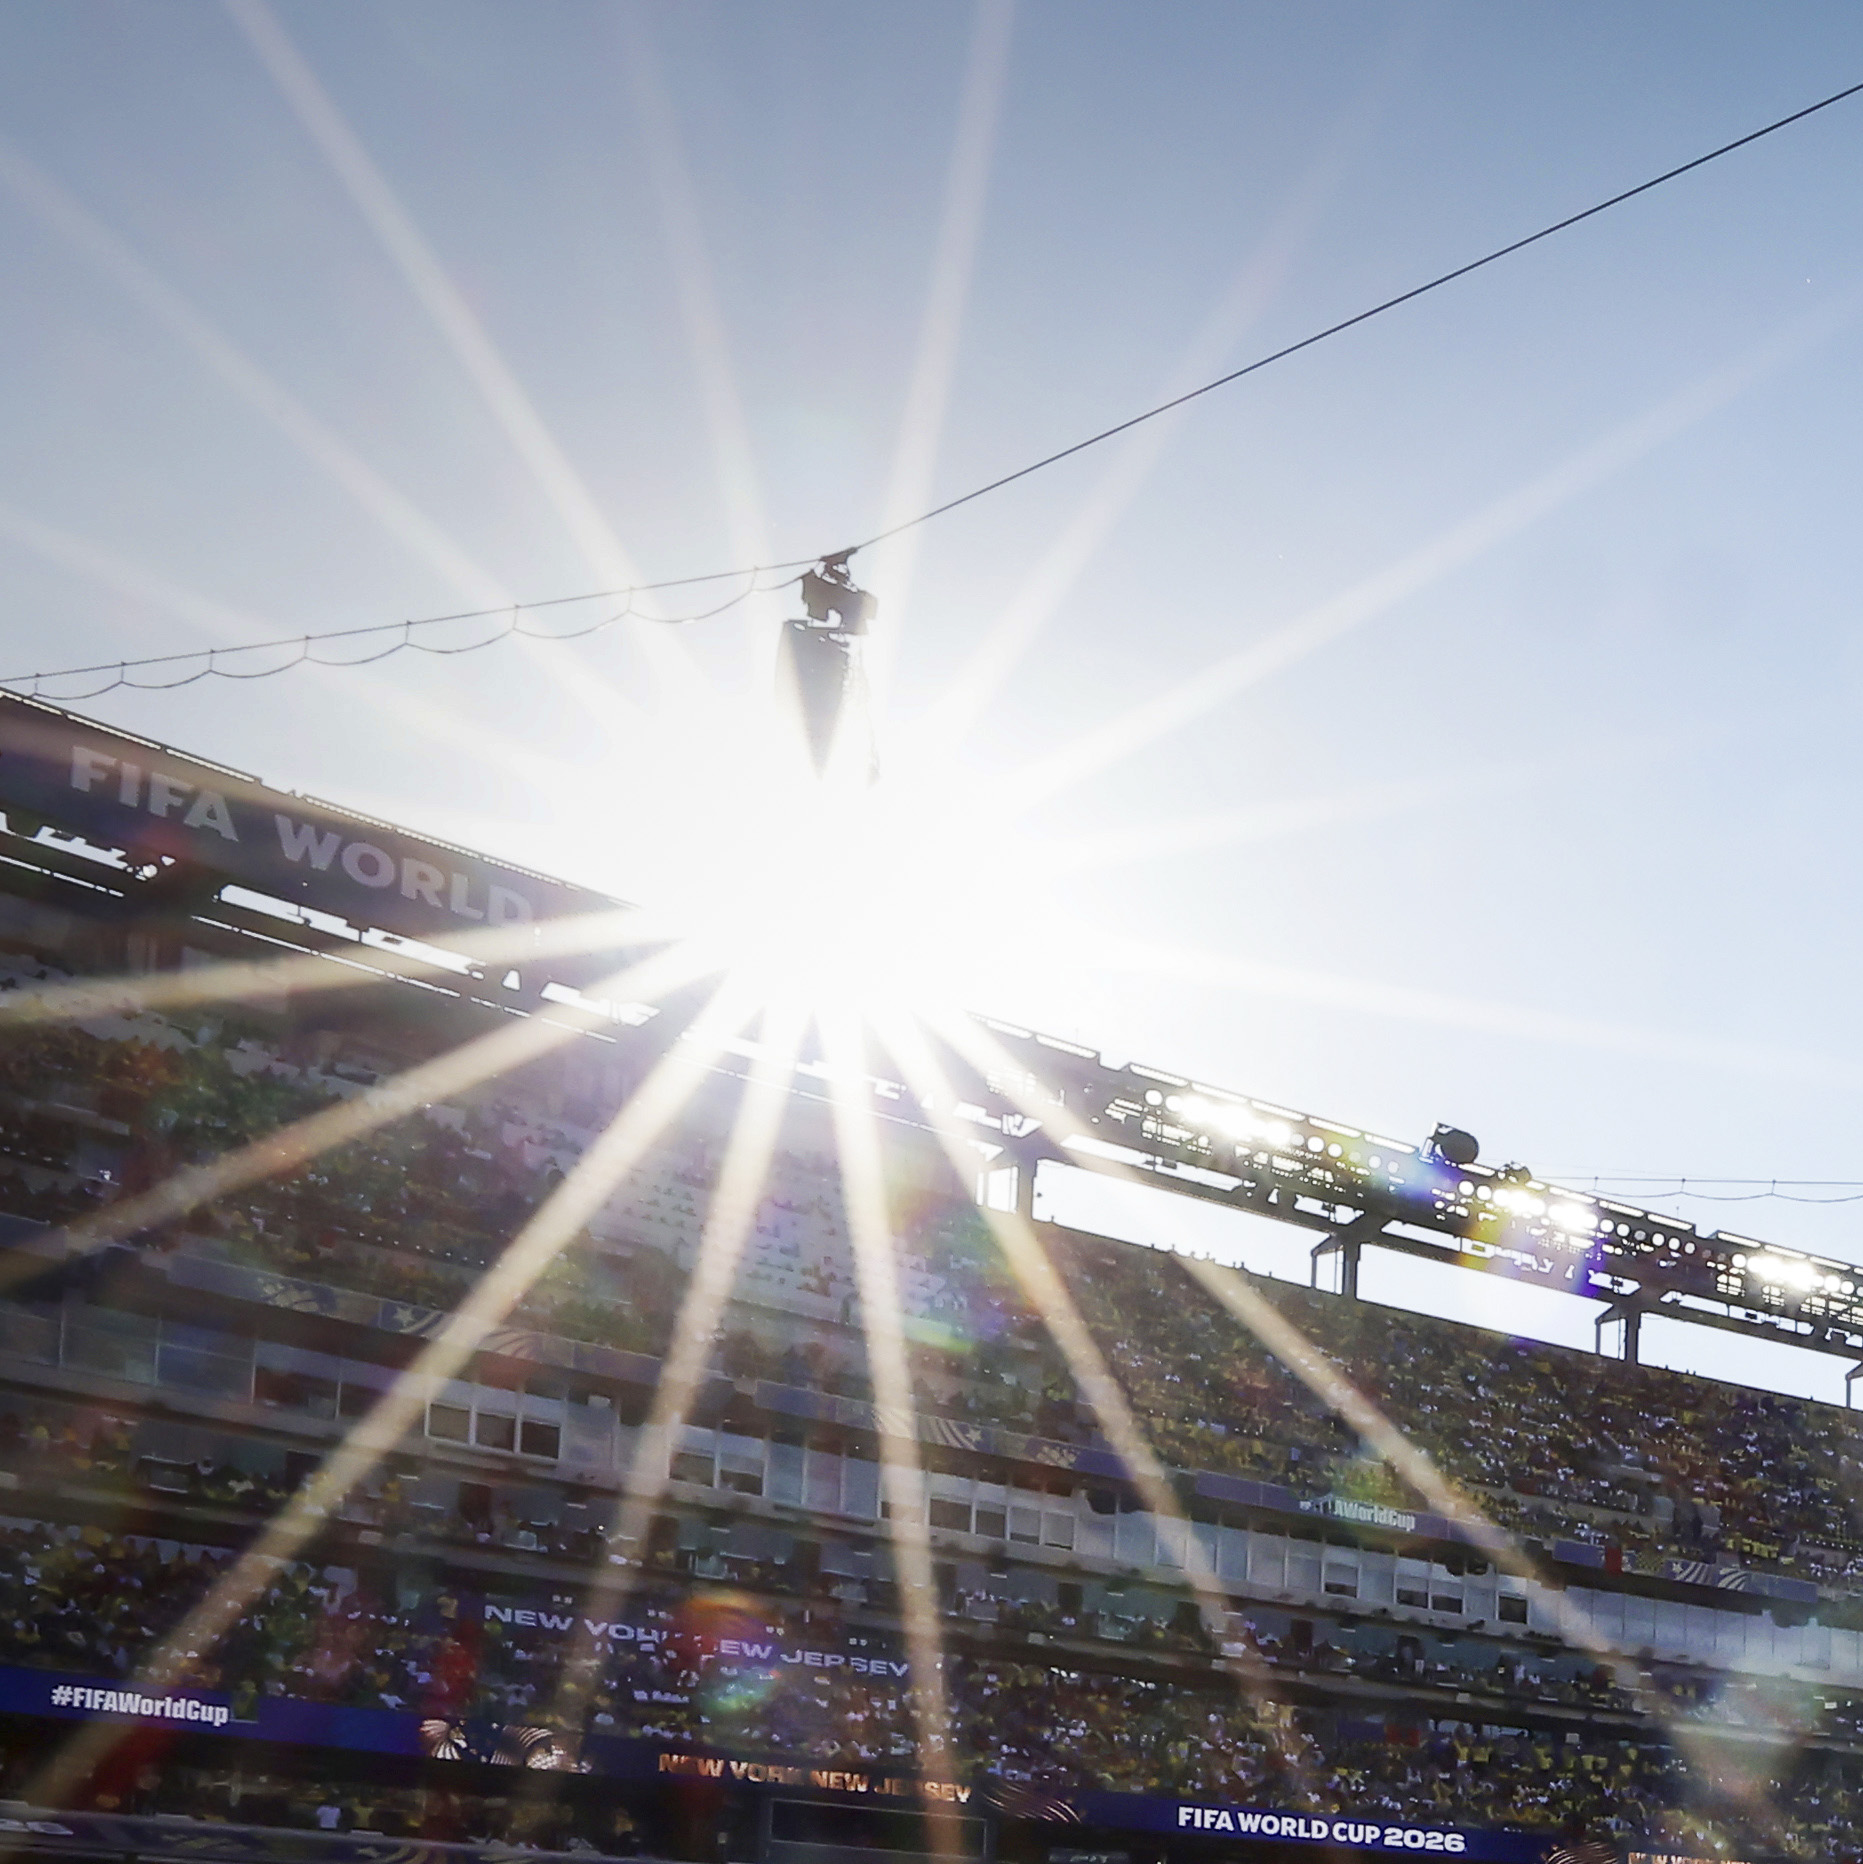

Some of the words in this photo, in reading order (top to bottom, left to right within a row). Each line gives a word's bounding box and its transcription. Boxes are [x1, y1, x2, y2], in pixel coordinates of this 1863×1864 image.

[70, 745, 239, 842] FIFA
[275, 814, 533, 927] WORLD
[1301, 1498, 1416, 1532] AWorldCup
[484, 1605, 573, 1631] NEW
[51, 1685, 229, 1727] #FIFAWorldCup
[658, 1753, 724, 1778] NW
[810, 1769, 869, 1793] NEW
[874, 1777, 972, 1804] JESEY
[1178, 1806, 1235, 1832] FIFA
[1237, 1811, 1328, 1840] WORLD
[1332, 1822, 1381, 1844] CUP
[1383, 1827, 1466, 1852] 2026
